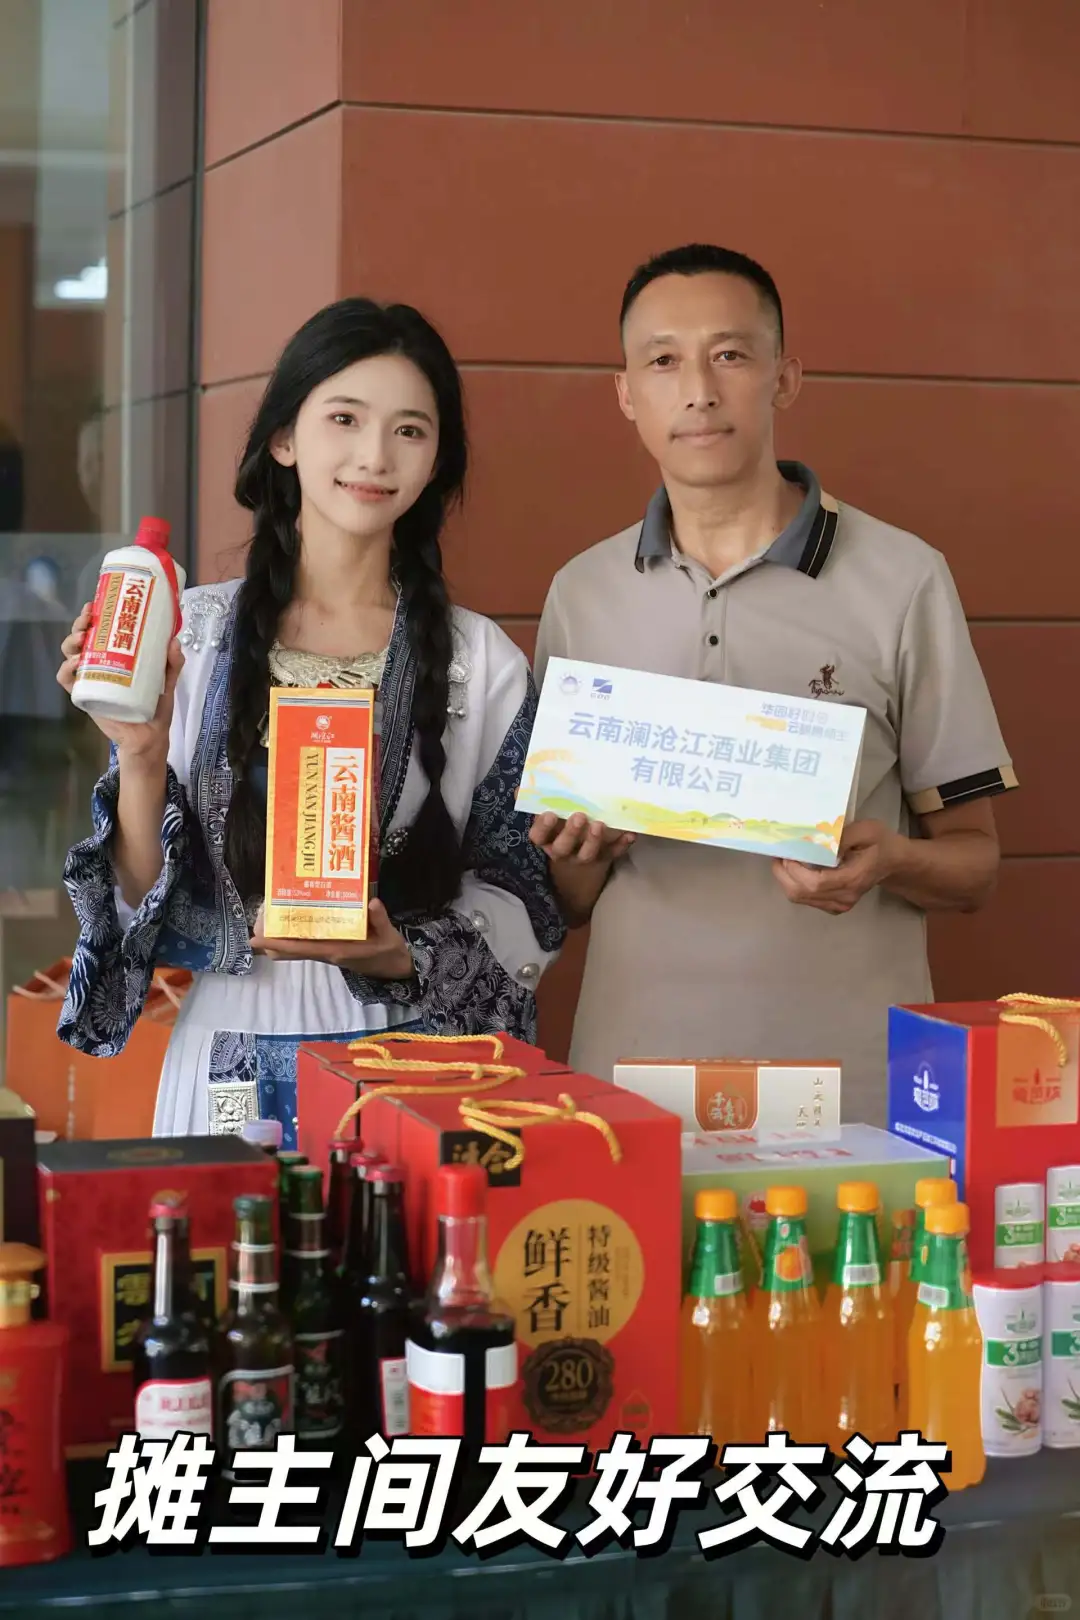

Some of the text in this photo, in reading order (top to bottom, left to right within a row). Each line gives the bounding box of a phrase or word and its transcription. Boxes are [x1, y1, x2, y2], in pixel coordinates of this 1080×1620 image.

[112, 579, 146, 651] 云南酱酒
[568, 711, 823, 777] 云南澜沧江酒业集团
[630, 756, 743, 798] 有限公司
[302, 753, 319, 872] YUN NAN JIANG JIU
[328, 755, 360, 873] 云南酱酒
[523, 1226, 571, 1333] 鲜香
[587, 1224, 612, 1329] 特级酱油
[544, 1358, 594, 1391] 280
